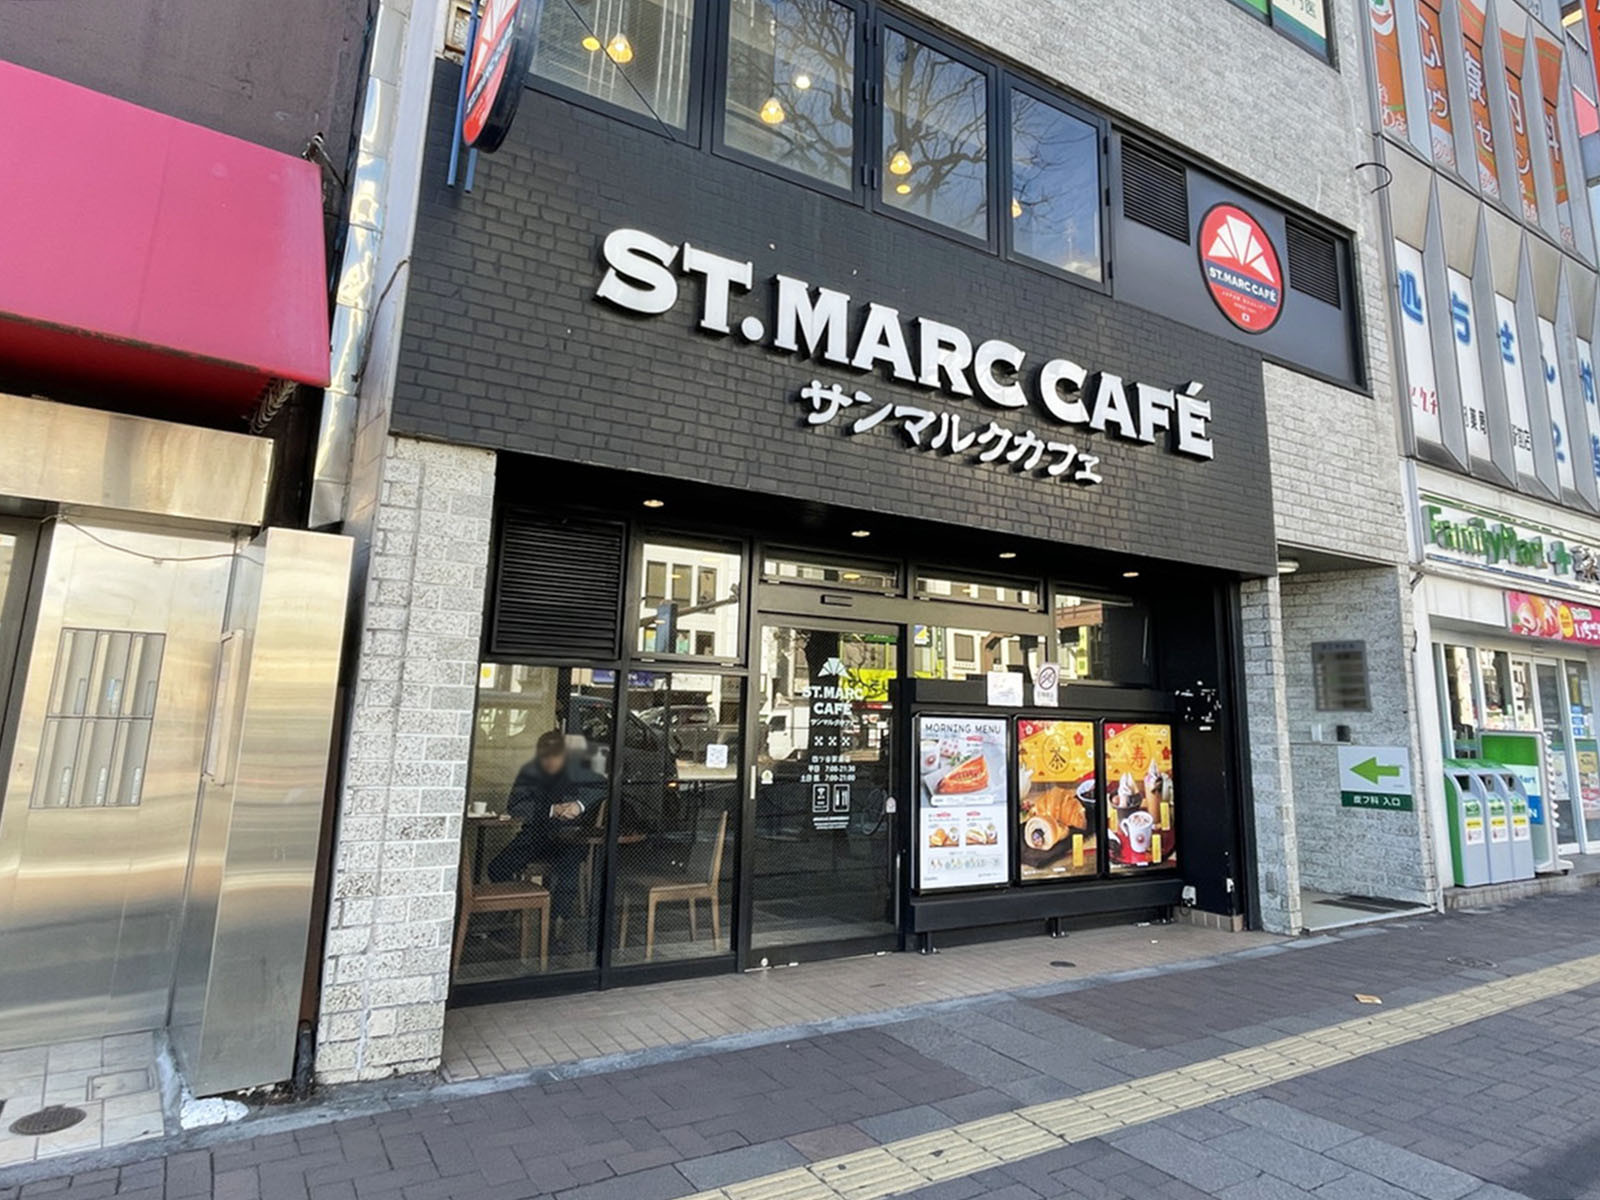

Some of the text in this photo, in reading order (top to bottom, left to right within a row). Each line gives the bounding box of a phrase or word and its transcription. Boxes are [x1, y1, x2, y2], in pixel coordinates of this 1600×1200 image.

[1208, 266, 1277, 303] ST.MARC CAFÉ
[596, 228, 1214, 460] ST.MARC CAFÉ
[801, 380, 1104, 484] サンマルクカフェ
[802, 685, 865, 701] ST.MARC
[813, 700, 852, 715] CAFÉ
[924, 722, 1001, 735] MORNING MENU
[1383, 796, 1401, 807] 入口
